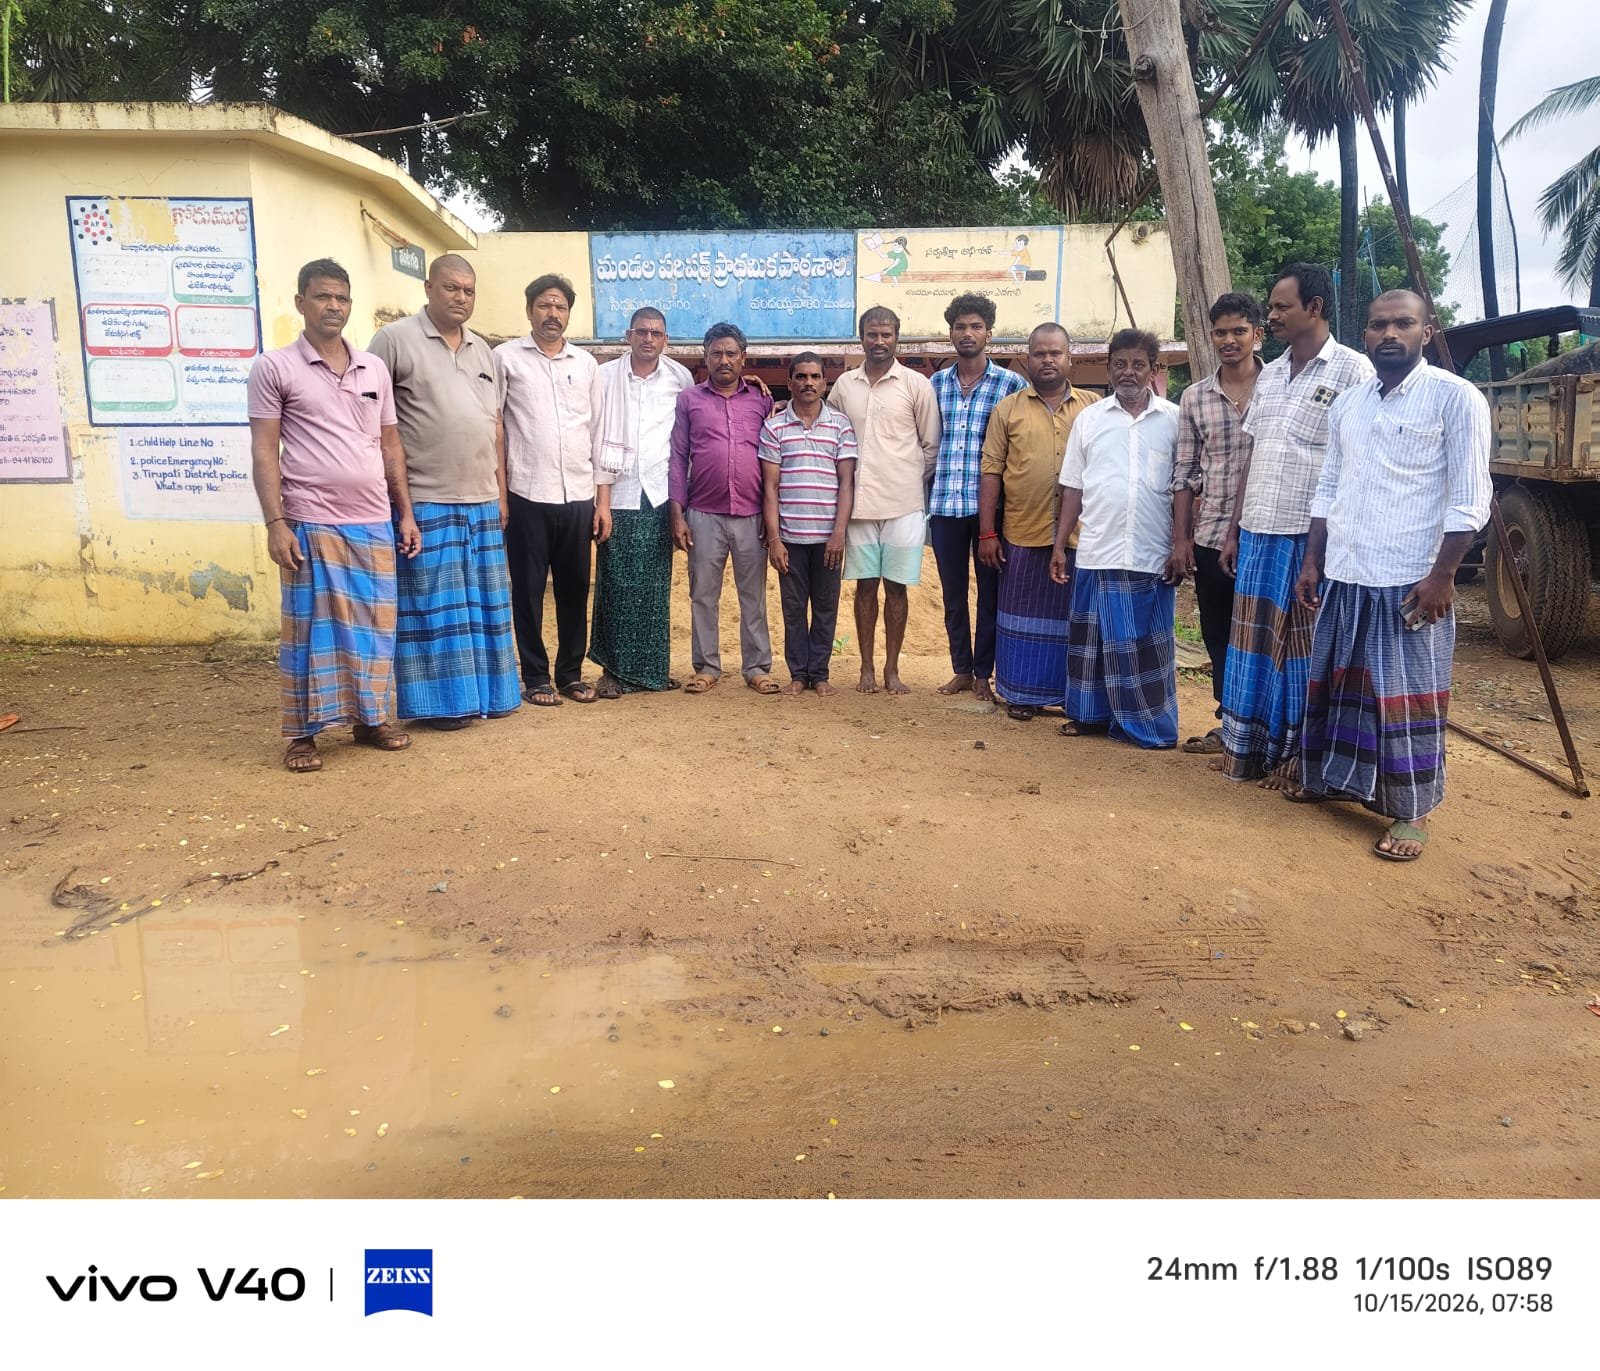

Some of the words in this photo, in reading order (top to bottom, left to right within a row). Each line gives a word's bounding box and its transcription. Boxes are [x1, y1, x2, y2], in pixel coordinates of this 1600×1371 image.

[596, 252, 656, 281] మండల
[159, 438, 176, 449] Help
[179, 438, 199, 447] Line
[184, 469, 218, 479] District
[219, 470, 248, 482] police
